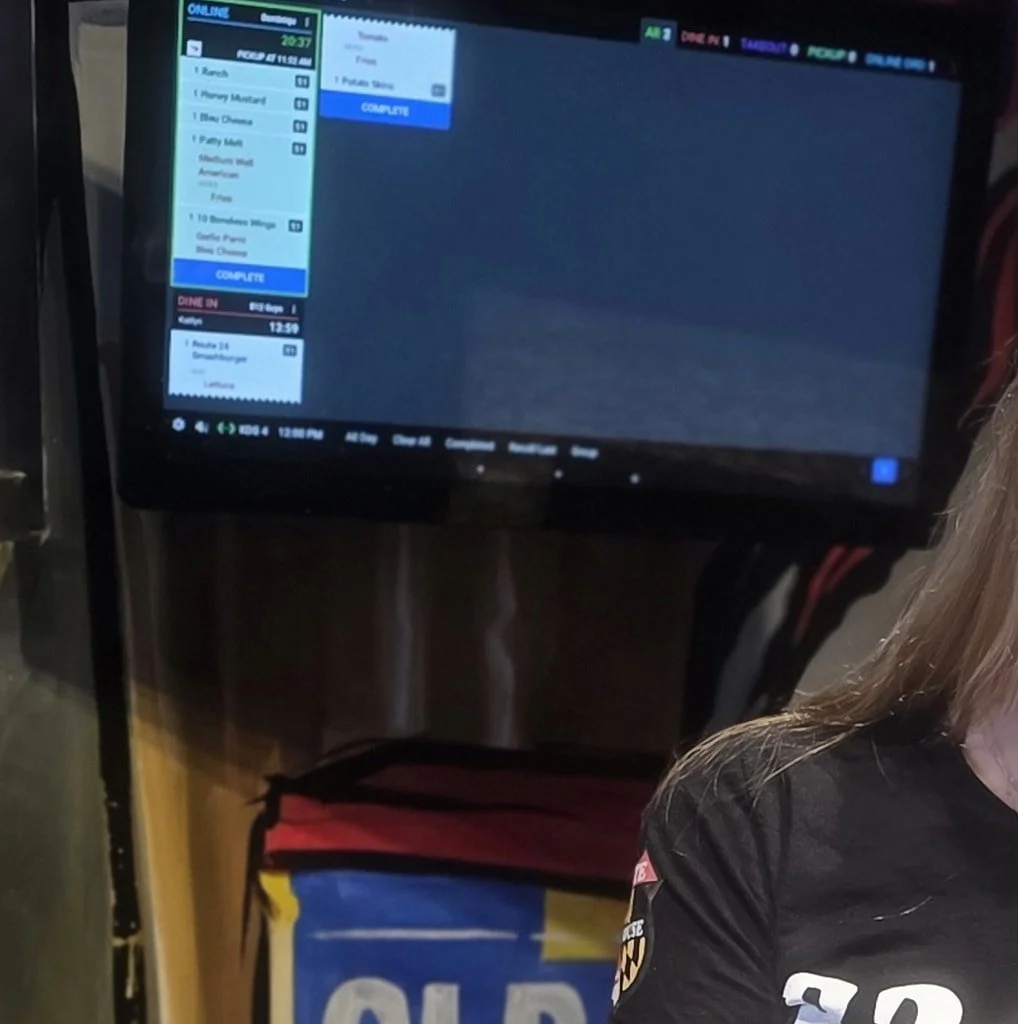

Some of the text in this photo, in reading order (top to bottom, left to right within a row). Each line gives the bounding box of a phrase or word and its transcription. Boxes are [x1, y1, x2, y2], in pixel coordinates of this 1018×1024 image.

[187, 3, 229, 19] ONLINE
[281, 34, 312, 48] 20:37
[681, 31, 704, 44] DINE
[202, 66, 228, 78] Ranch
[200, 90, 228, 103] Honey
[230, 93, 267, 105] Mustard
[361, 102, 409, 118] COMPLETE
[221, 115, 253, 126] Cheese
[199, 135, 221, 147] Patty
[223, 137, 243, 147] Melt
[198, 154, 233, 165] Medium
[198, 168, 239, 179] American
[211, 193, 233, 203] Fries
[209, 214, 248, 226] Boneless
[250, 219, 276, 230] Wings
[196, 232, 220, 242] Garlic
[217, 247, 247, 257] Cheese
[215, 268, 265, 283] COMPLETE
[178, 296, 219, 309] DINE IN
[192, 339, 217, 350] Route
[192, 351, 247, 364] Smashburger
[204, 380, 235, 390] Lettuce
[306, 428, 324, 440] PM
